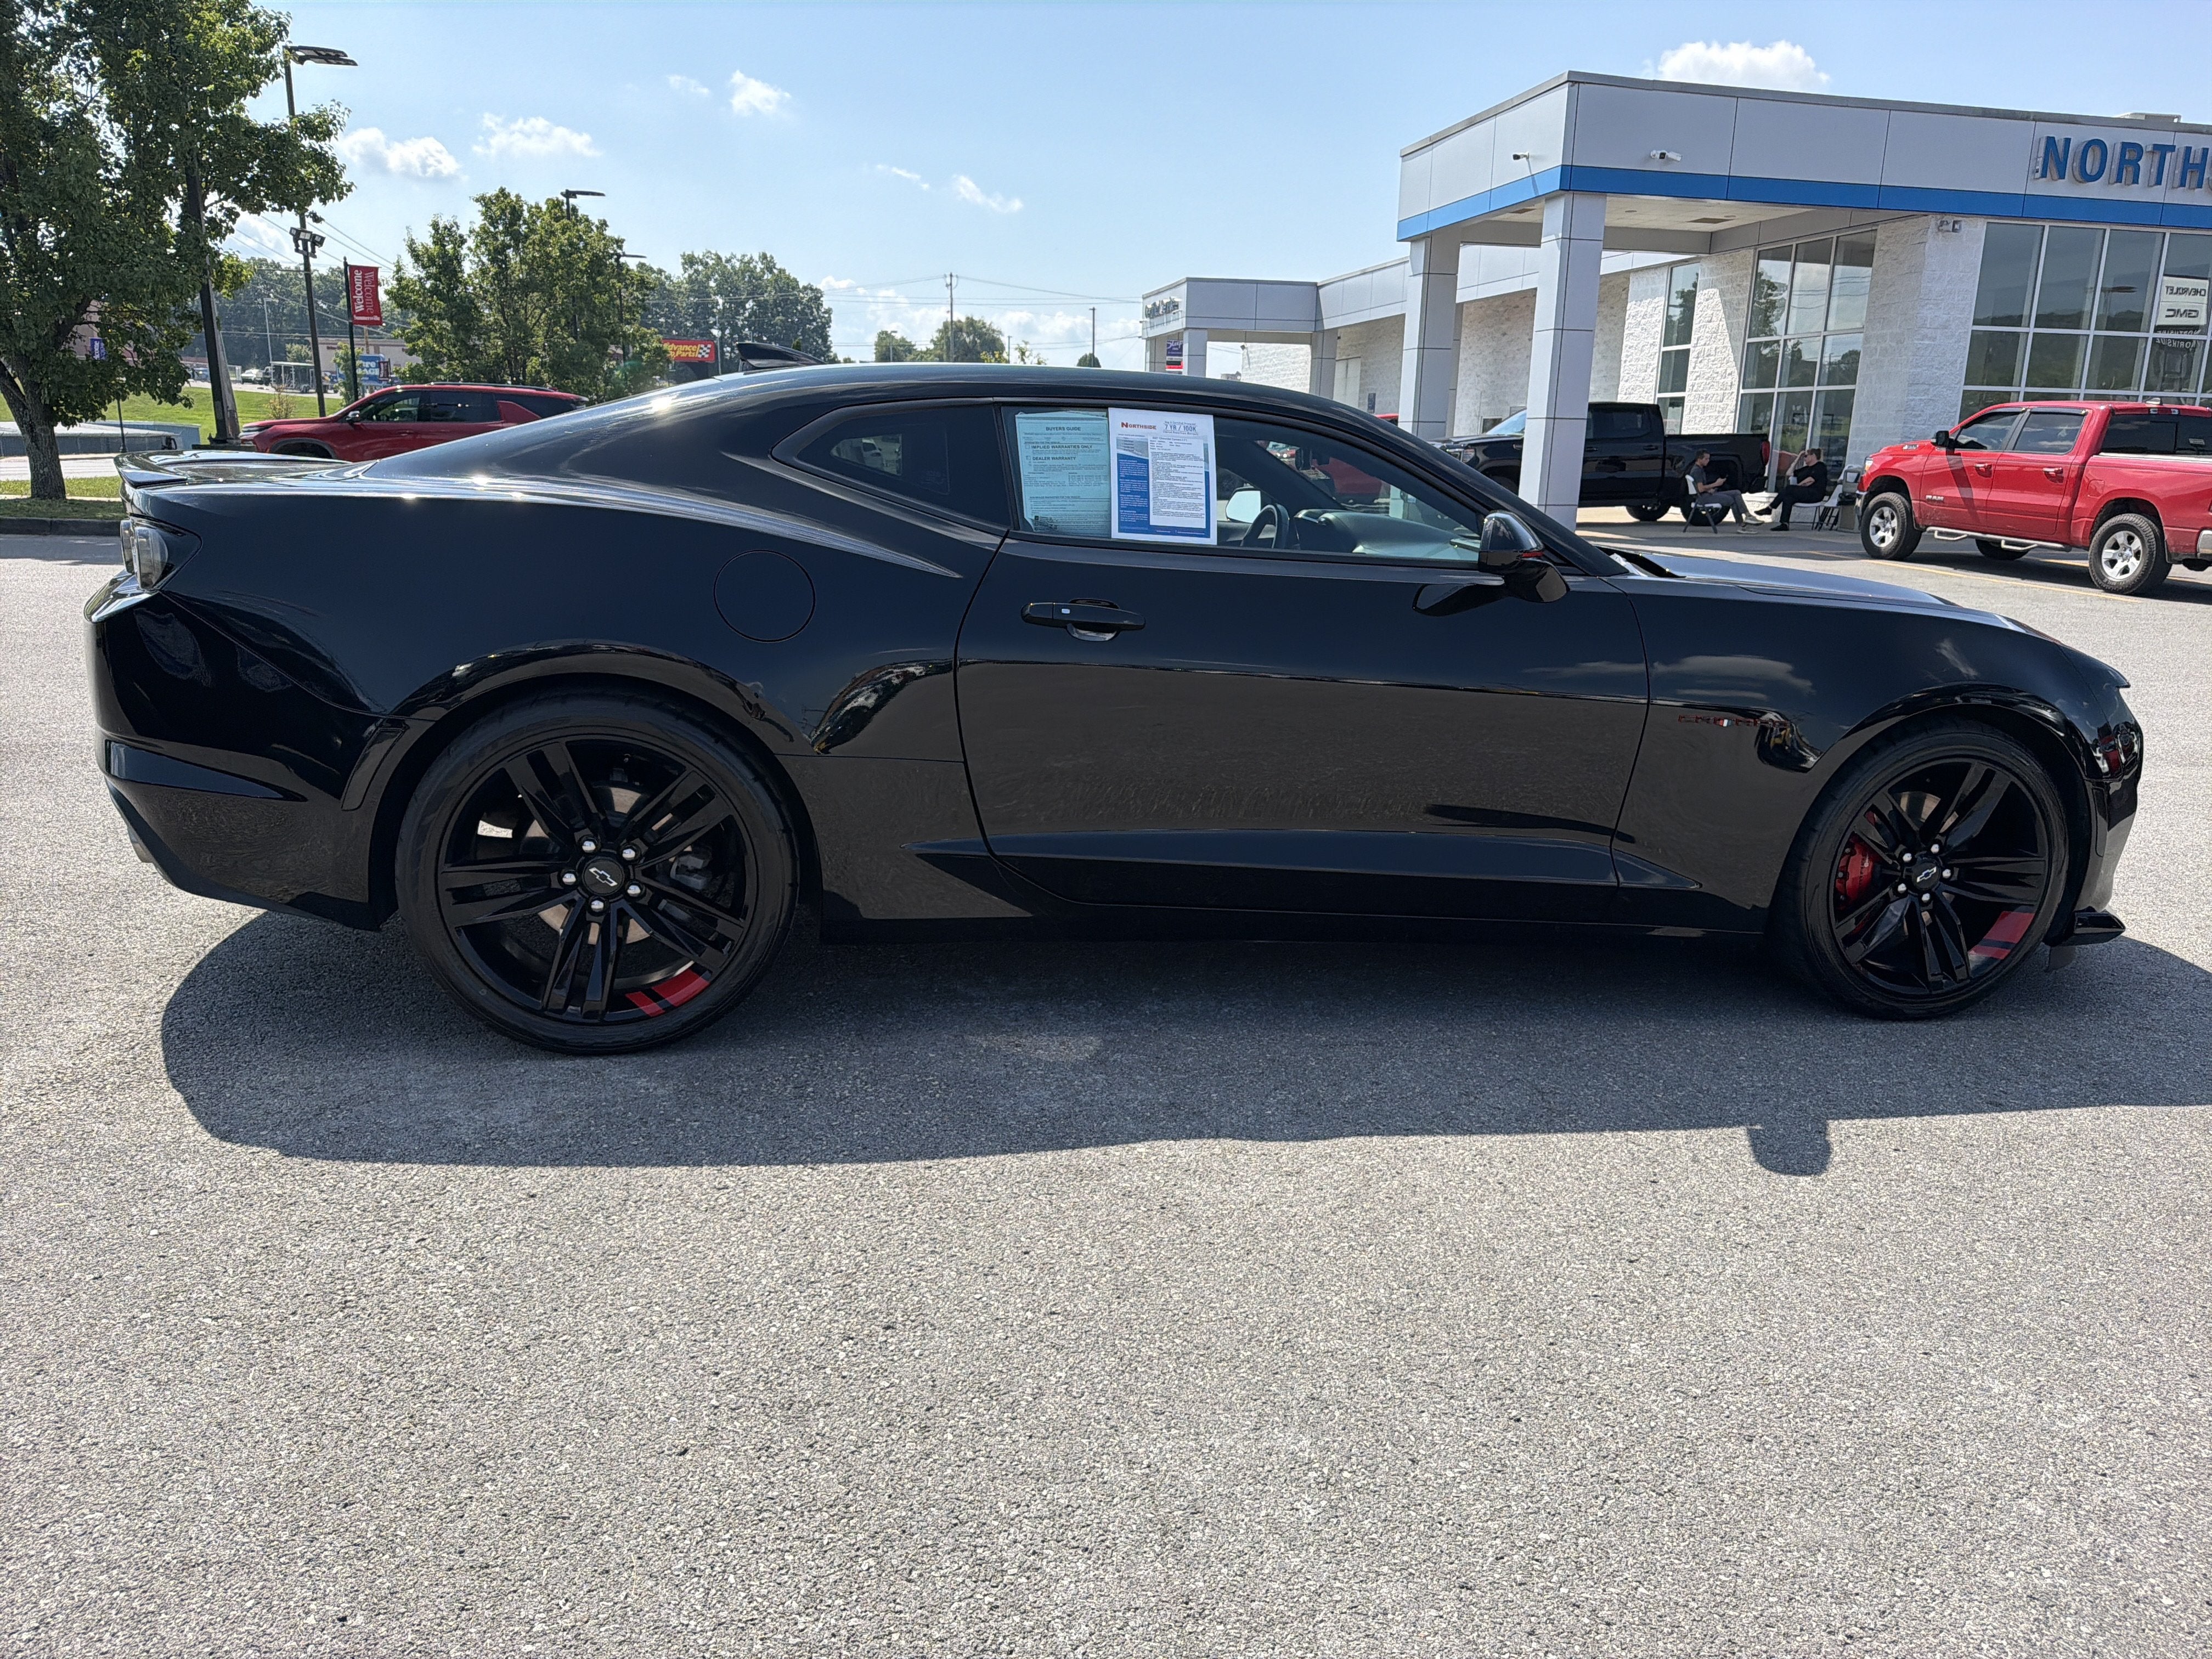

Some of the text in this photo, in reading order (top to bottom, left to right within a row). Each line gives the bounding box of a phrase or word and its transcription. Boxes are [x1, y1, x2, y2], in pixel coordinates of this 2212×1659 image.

[2039, 136, 2212, 189] NORTH
[353, 269, 364, 313] Welcome
[364, 271, 375, 314] Welcome
